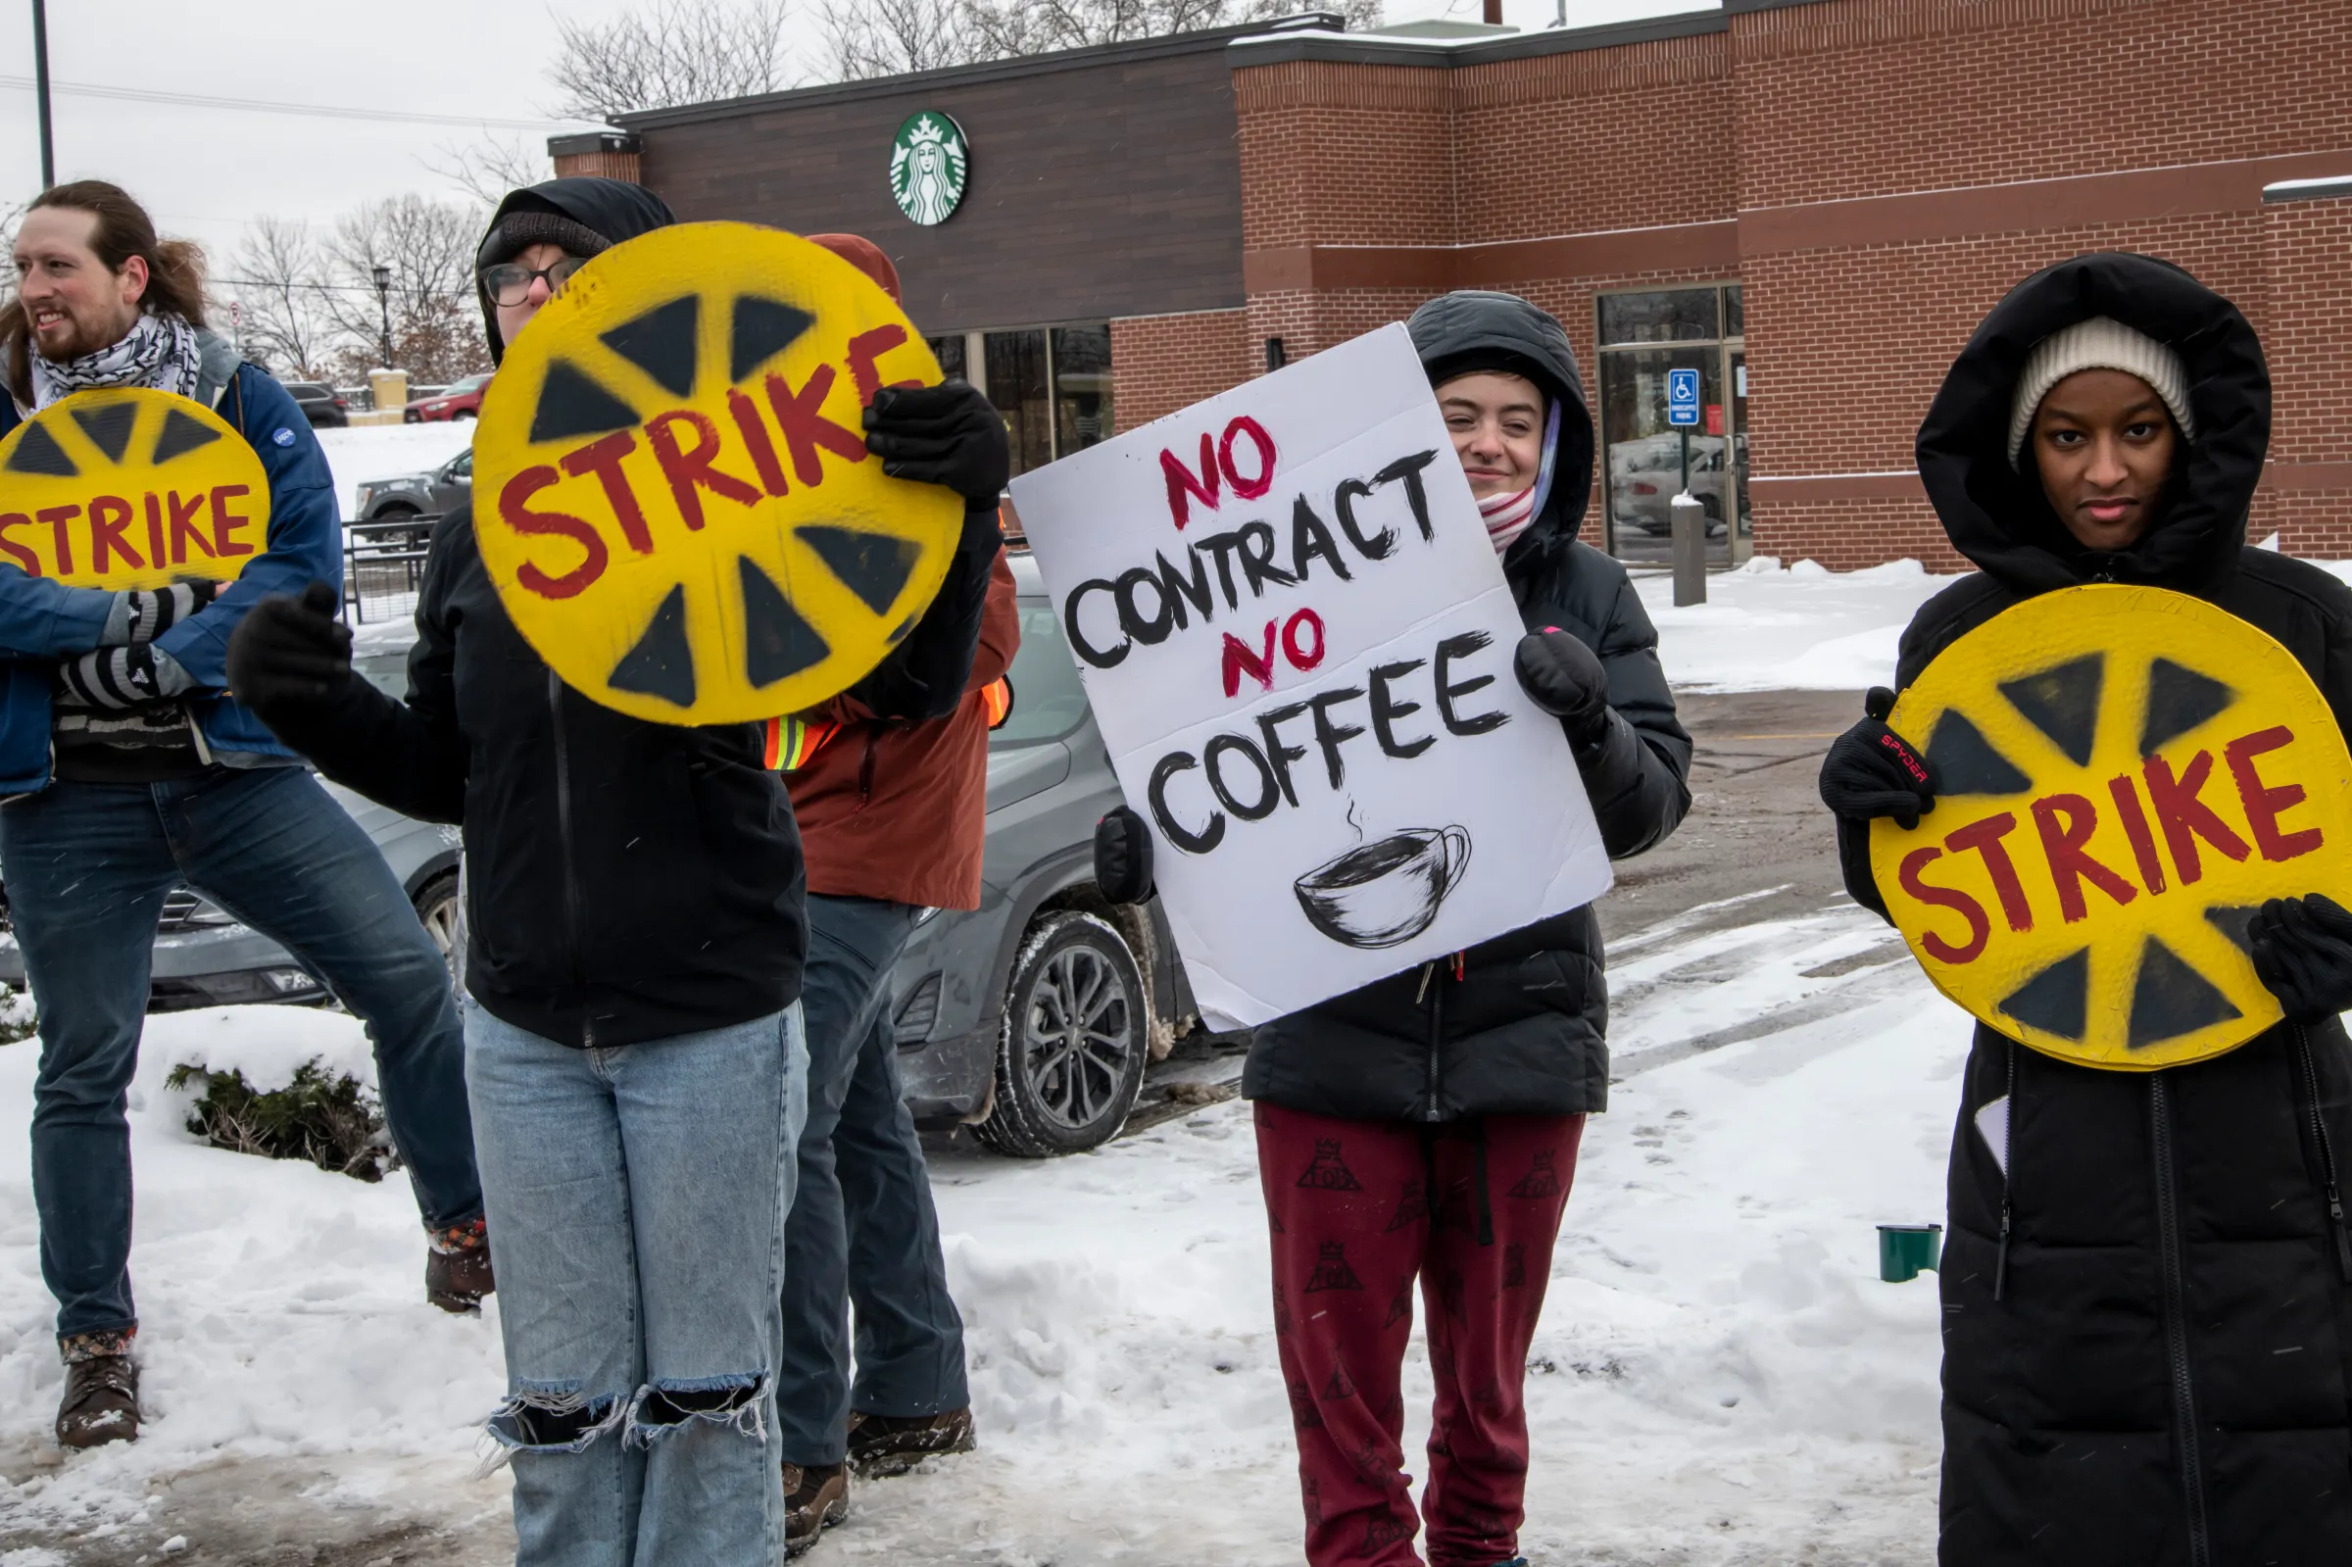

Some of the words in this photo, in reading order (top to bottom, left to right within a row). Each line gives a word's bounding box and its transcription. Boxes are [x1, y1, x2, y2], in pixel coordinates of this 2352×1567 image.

[1158, 415, 1278, 531] NO
[1064, 448, 1440, 669] CONTRACT
[1221, 607, 1326, 699] NO
[1147, 630, 1513, 855] COFFEE
[1880, 734, 1929, 784] SPYDER
[1898, 725, 2324, 965] STRIKE
